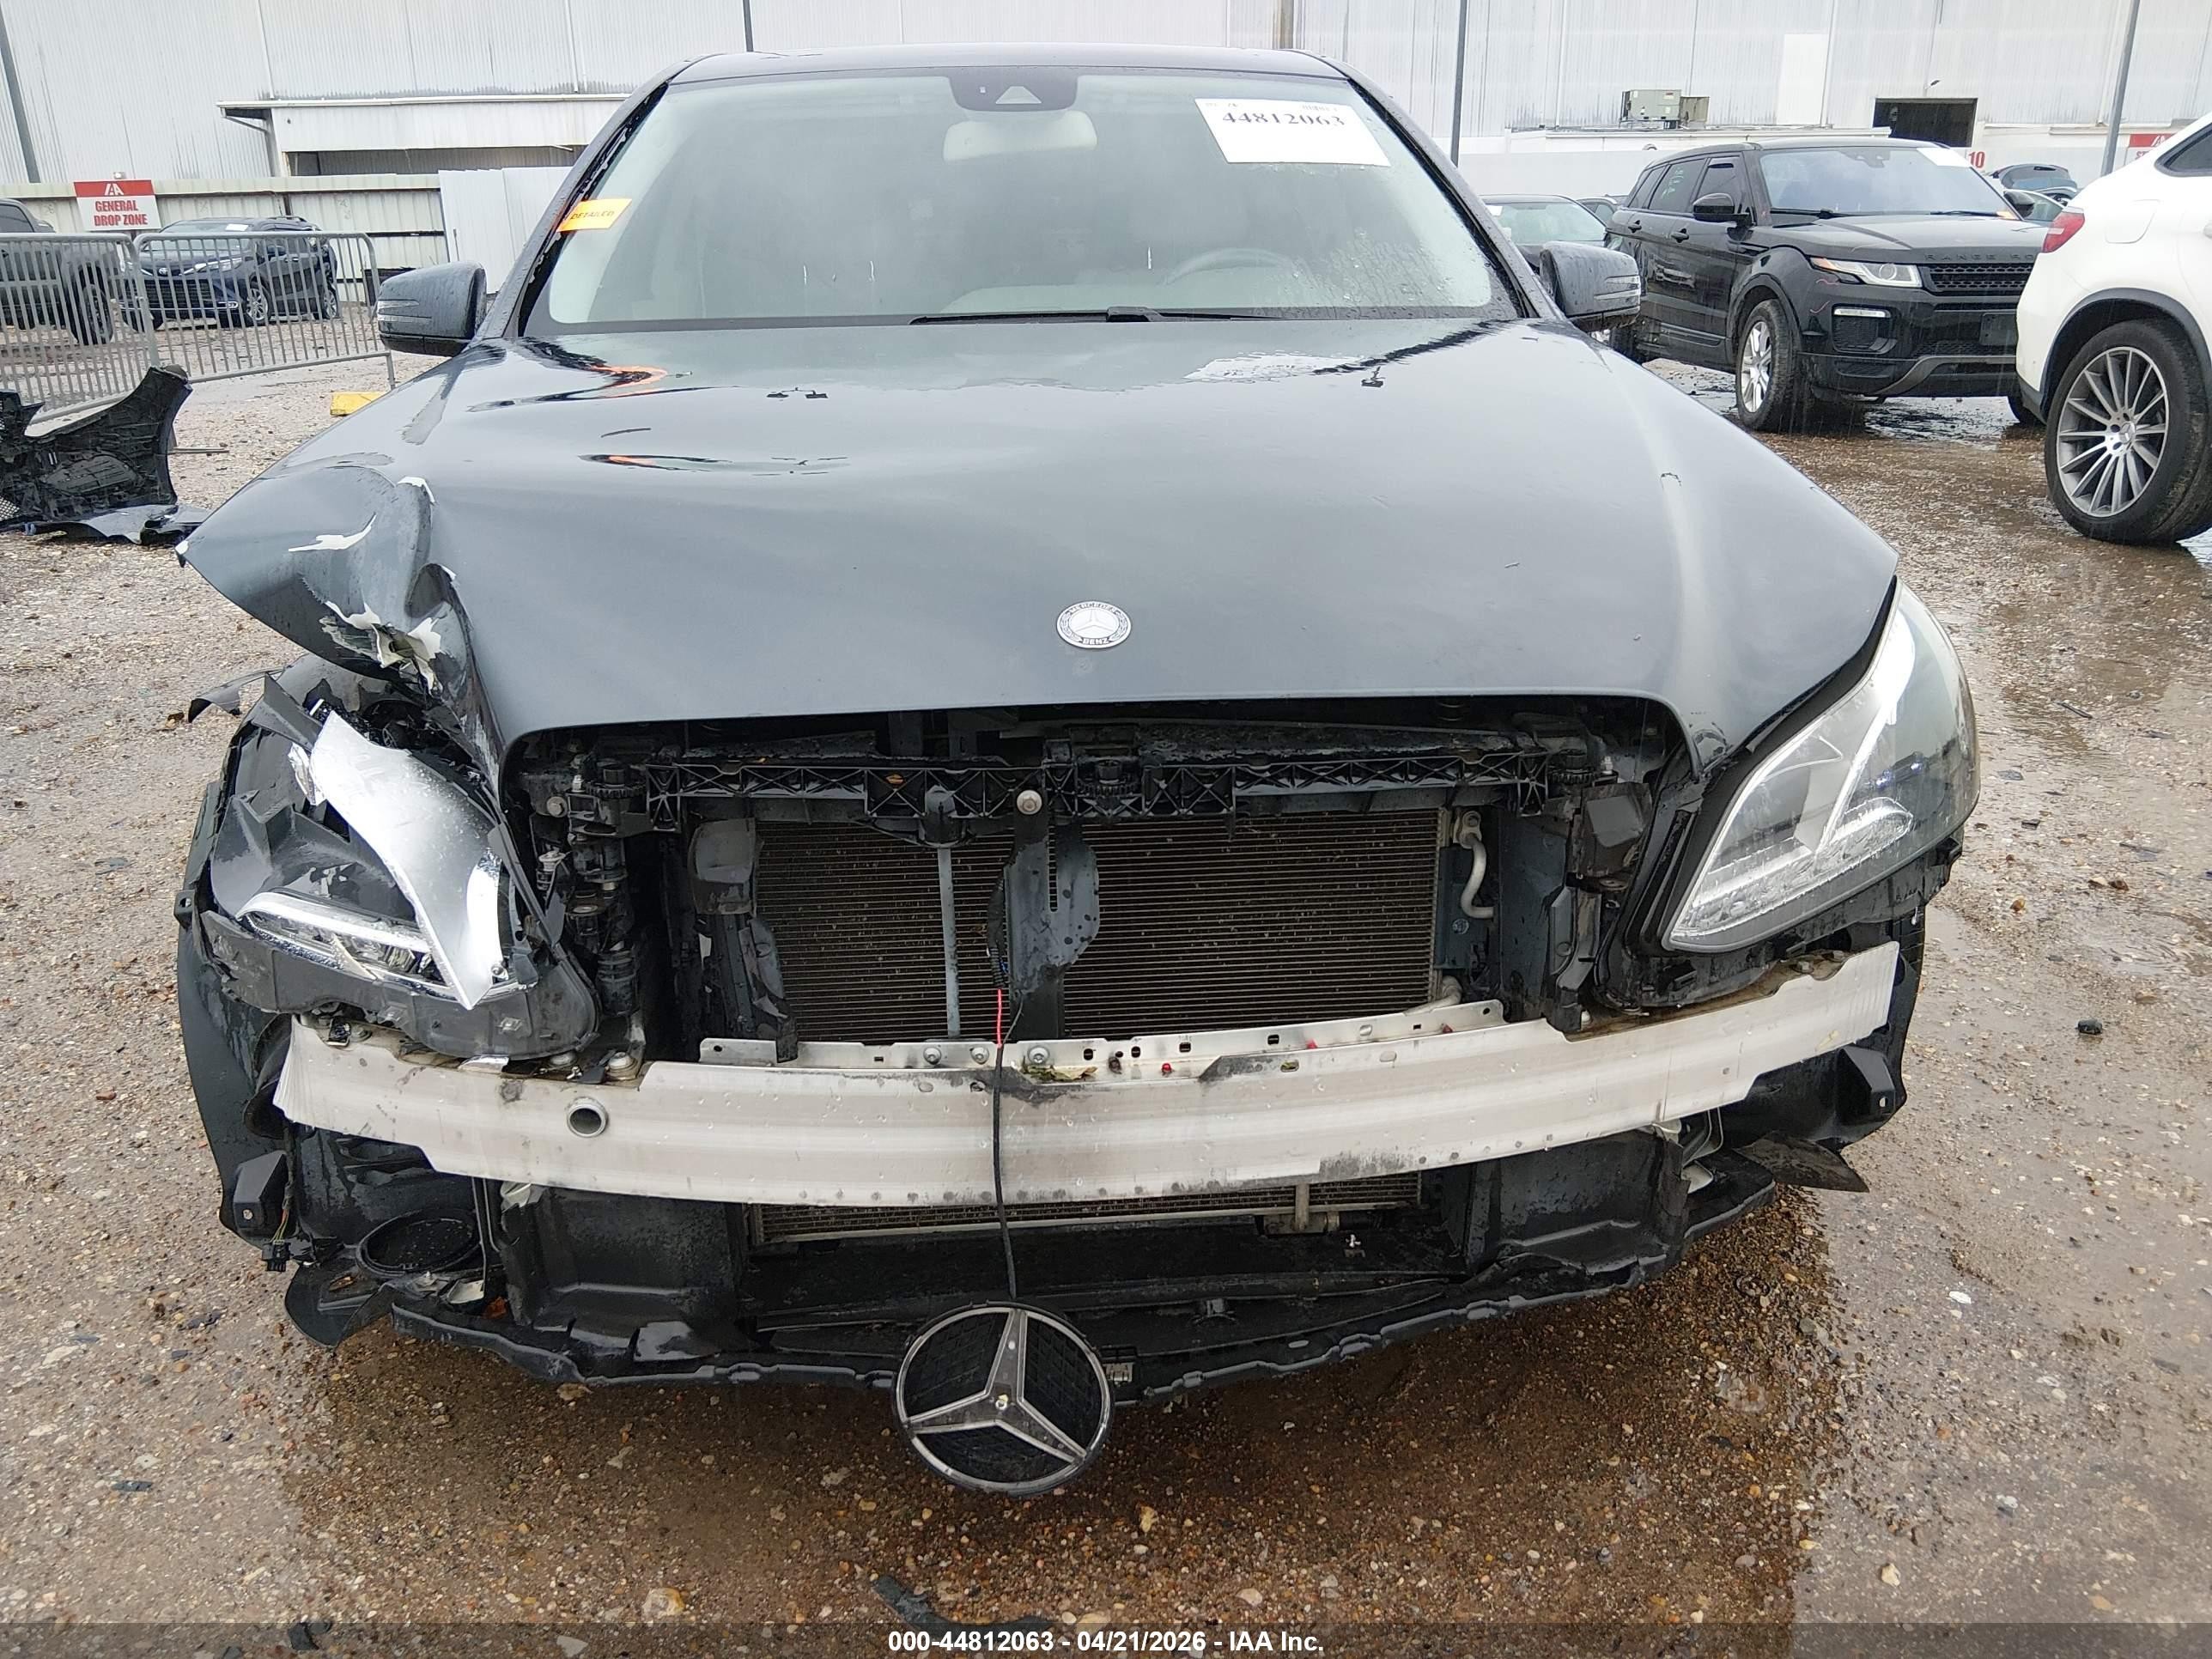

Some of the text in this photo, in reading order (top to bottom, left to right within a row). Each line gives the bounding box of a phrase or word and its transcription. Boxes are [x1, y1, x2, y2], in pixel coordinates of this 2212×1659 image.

[1223, 112, 1345, 125] 44812063
[1968, 151, 1985, 168] 10
[95, 200, 138, 212] GENERAL
[94, 214, 148, 226] DROP ZONE
